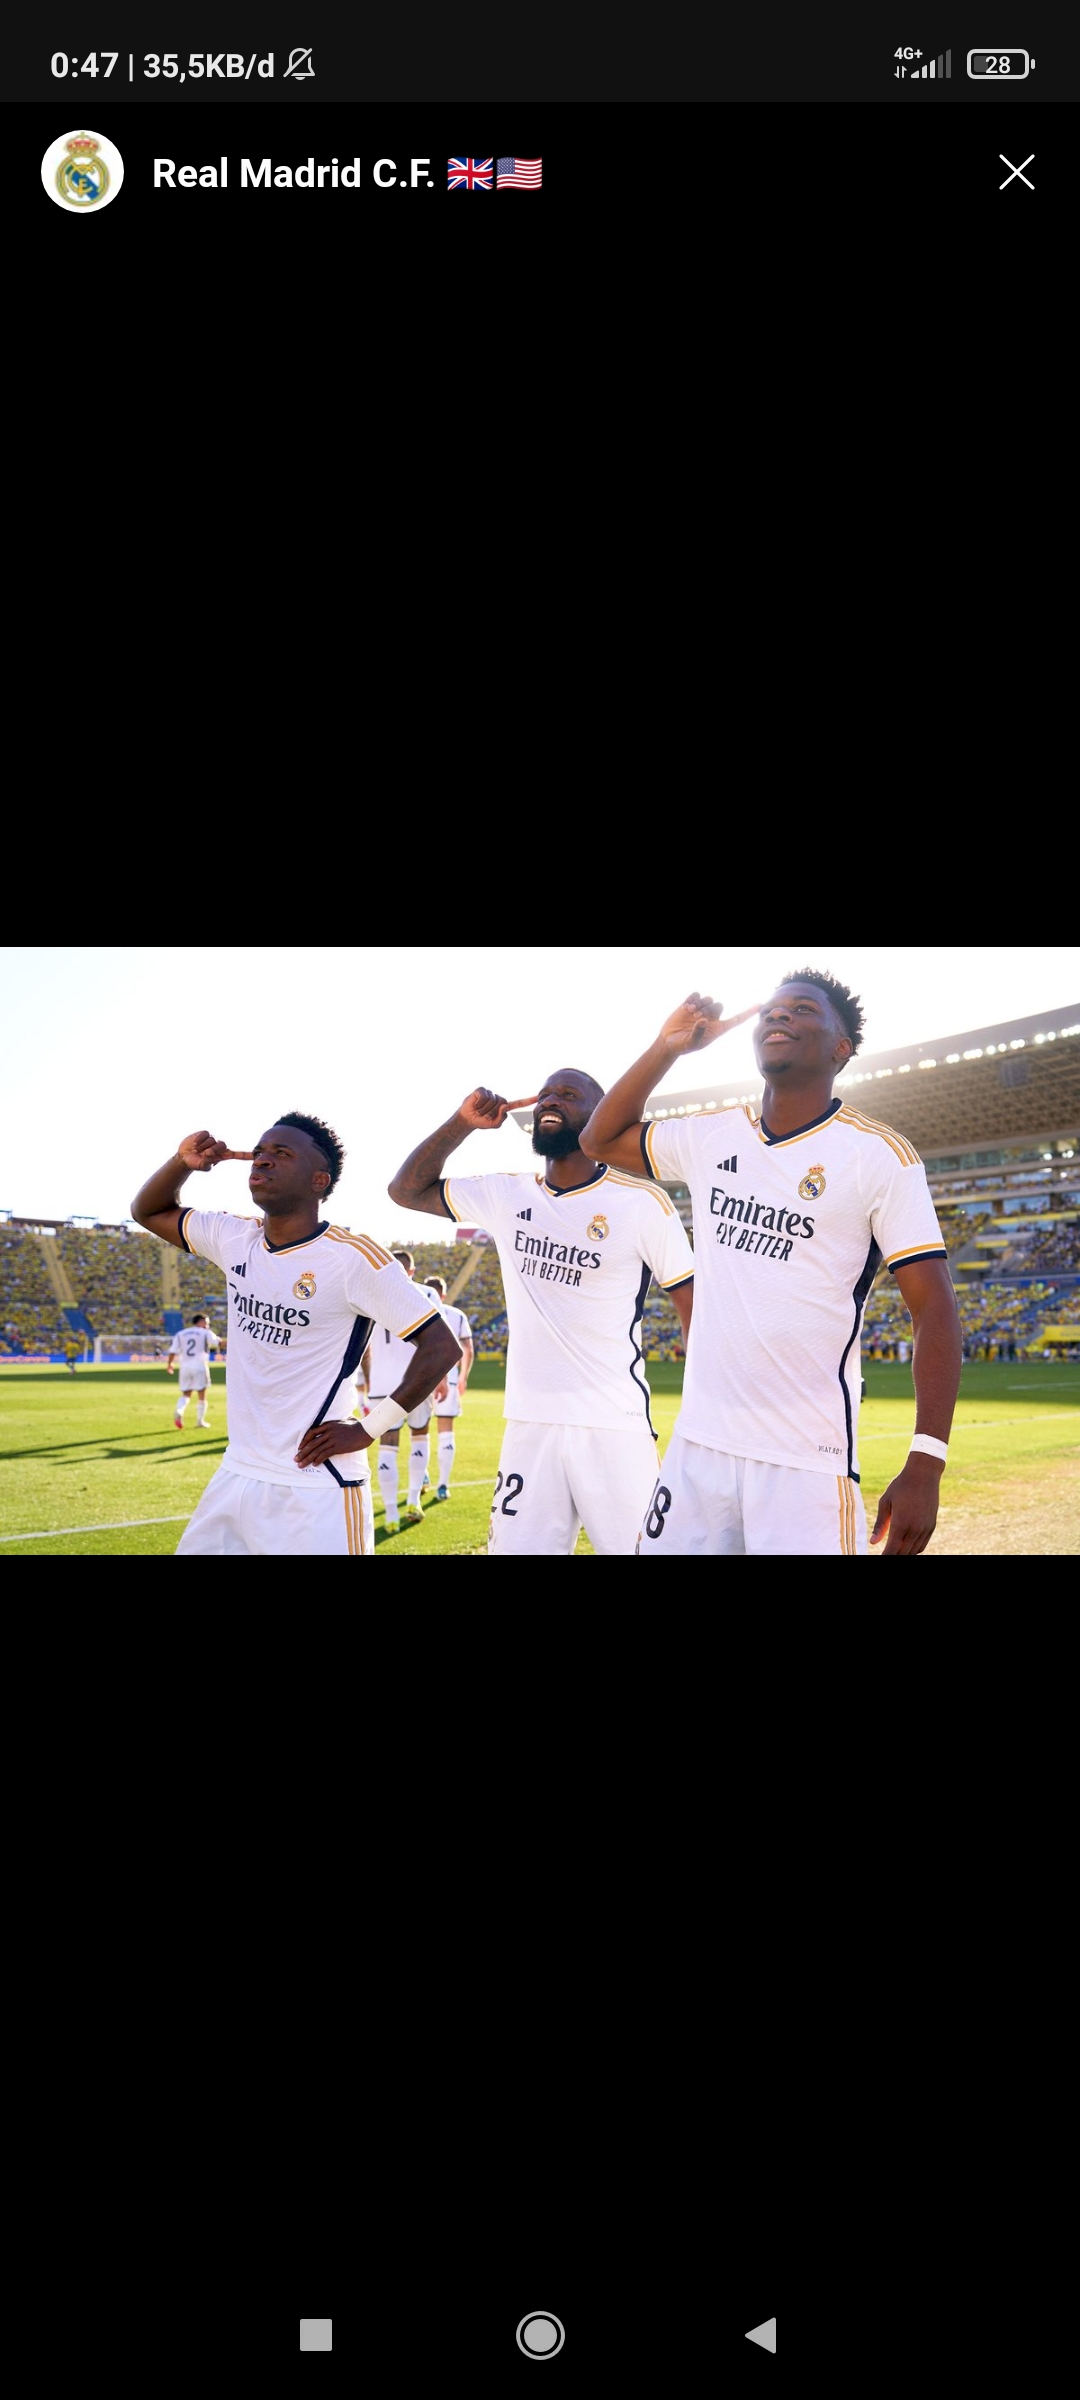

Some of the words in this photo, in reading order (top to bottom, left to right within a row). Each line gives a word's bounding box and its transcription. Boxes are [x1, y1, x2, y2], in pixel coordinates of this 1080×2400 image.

[50, 52, 119, 79] 0:47
[143, 53, 274, 84] 35,5KB/d
[894, 47, 923, 60] 4G+
[985, 55, 1011, 74] 28
[153, 157, 228, 188] Real
[240, 157, 361, 188] Madrid
[372, 158, 435, 188] C.F.
[709, 1187, 815, 1239] Emirates
[514, 1230, 602, 1270] Emirates
[716, 1222, 738, 1247] FLY
[735, 1229, 794, 1262] BETTER
[520, 1257, 538, 1277] FLY
[539, 1262, 582, 1287] BETTER
[229, 1282, 310, 1327] mirates
[186, 1338, 196, 1357] 2
